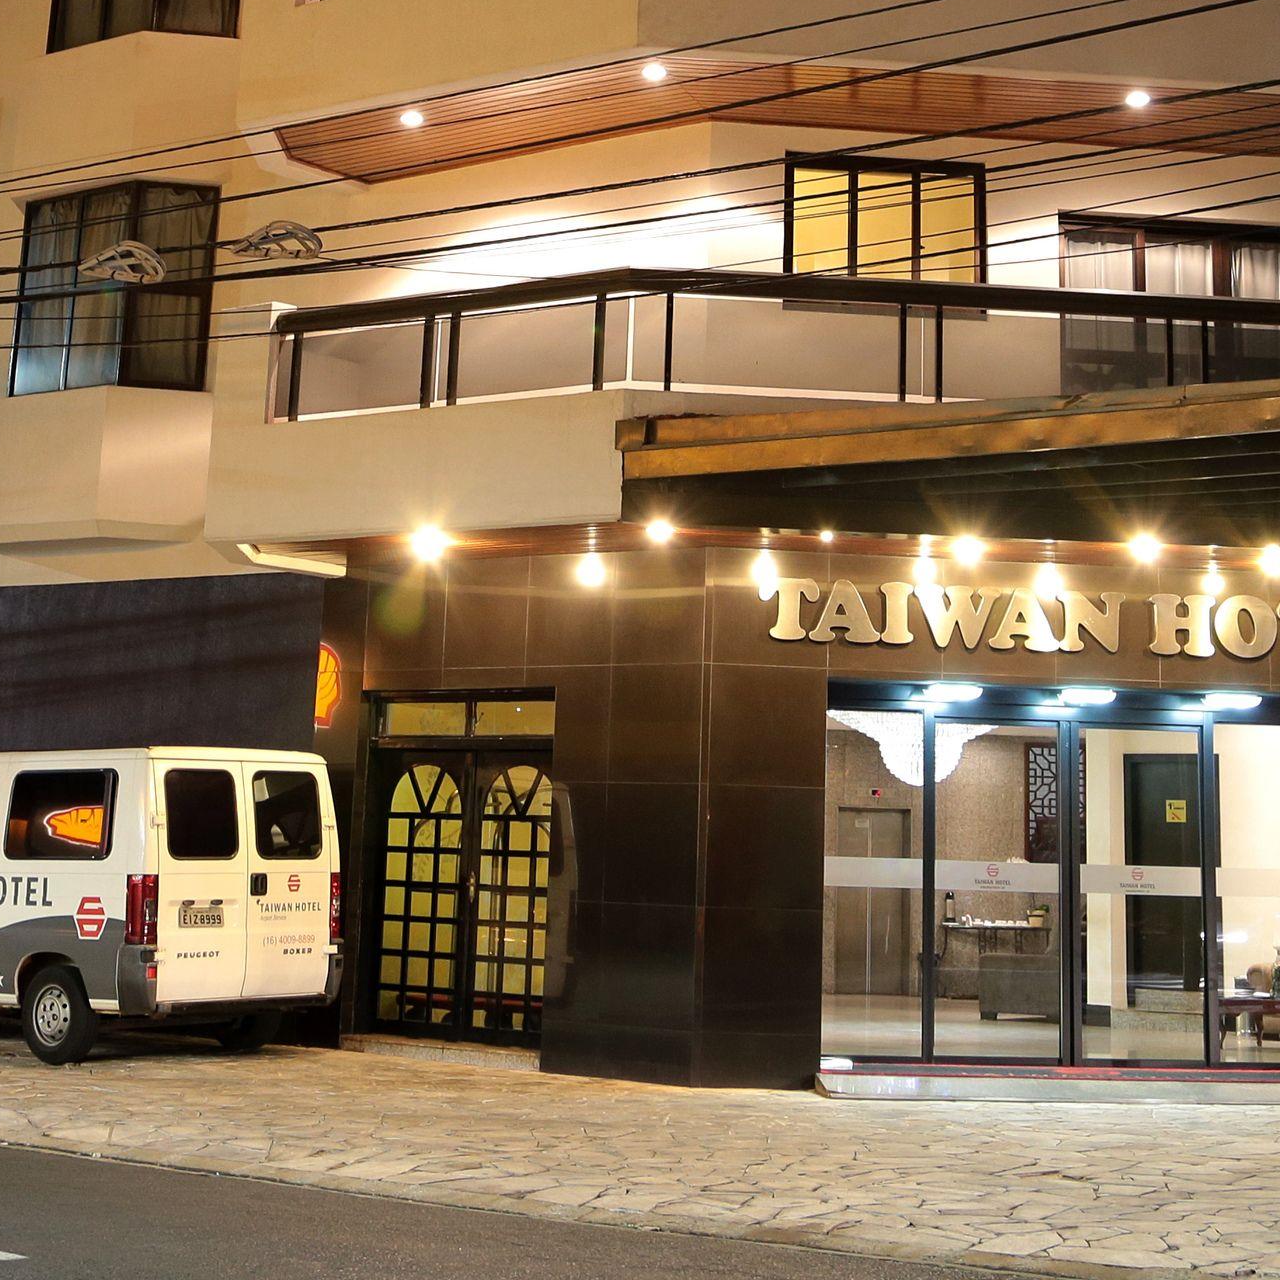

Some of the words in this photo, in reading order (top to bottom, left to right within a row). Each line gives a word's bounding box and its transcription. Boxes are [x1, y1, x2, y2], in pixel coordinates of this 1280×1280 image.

[766, 576, 1126, 654] TAIWAN
[260, 902, 293, 913] TAIWAN
[295, 902, 322, 912] HOTEL
[262, 935, 278, 947] (16)
[279, 934, 316, 944] 4009-8899
[177, 951, 220, 959] PEUGEOT
[283, 947, 313, 955] BOXER
